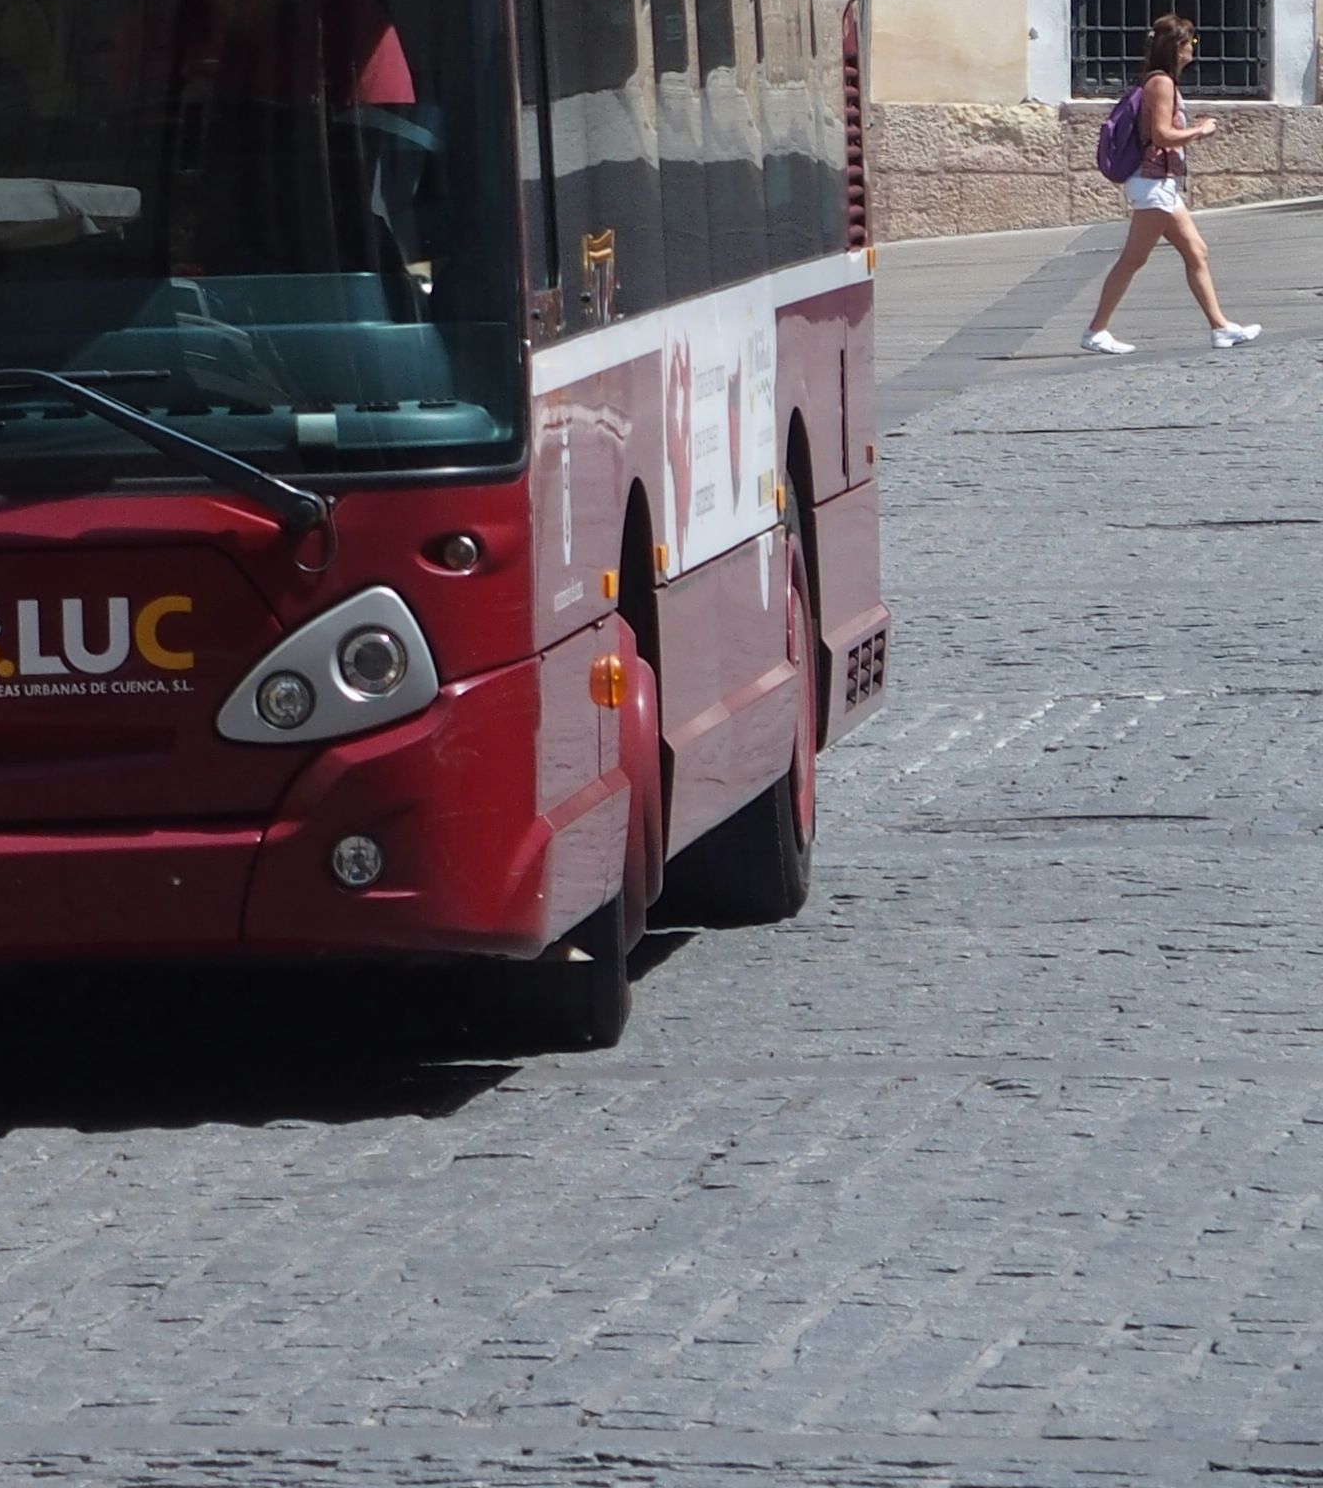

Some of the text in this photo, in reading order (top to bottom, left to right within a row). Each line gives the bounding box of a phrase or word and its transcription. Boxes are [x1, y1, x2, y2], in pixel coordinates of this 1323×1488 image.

[17, 595, 195, 675] LUC
[23, 682, 87, 697] URBANAS
[90, 681, 108, 695] DE
[111, 680, 170, 695] CUENCA,
[173, 679, 195, 692] S.L.
